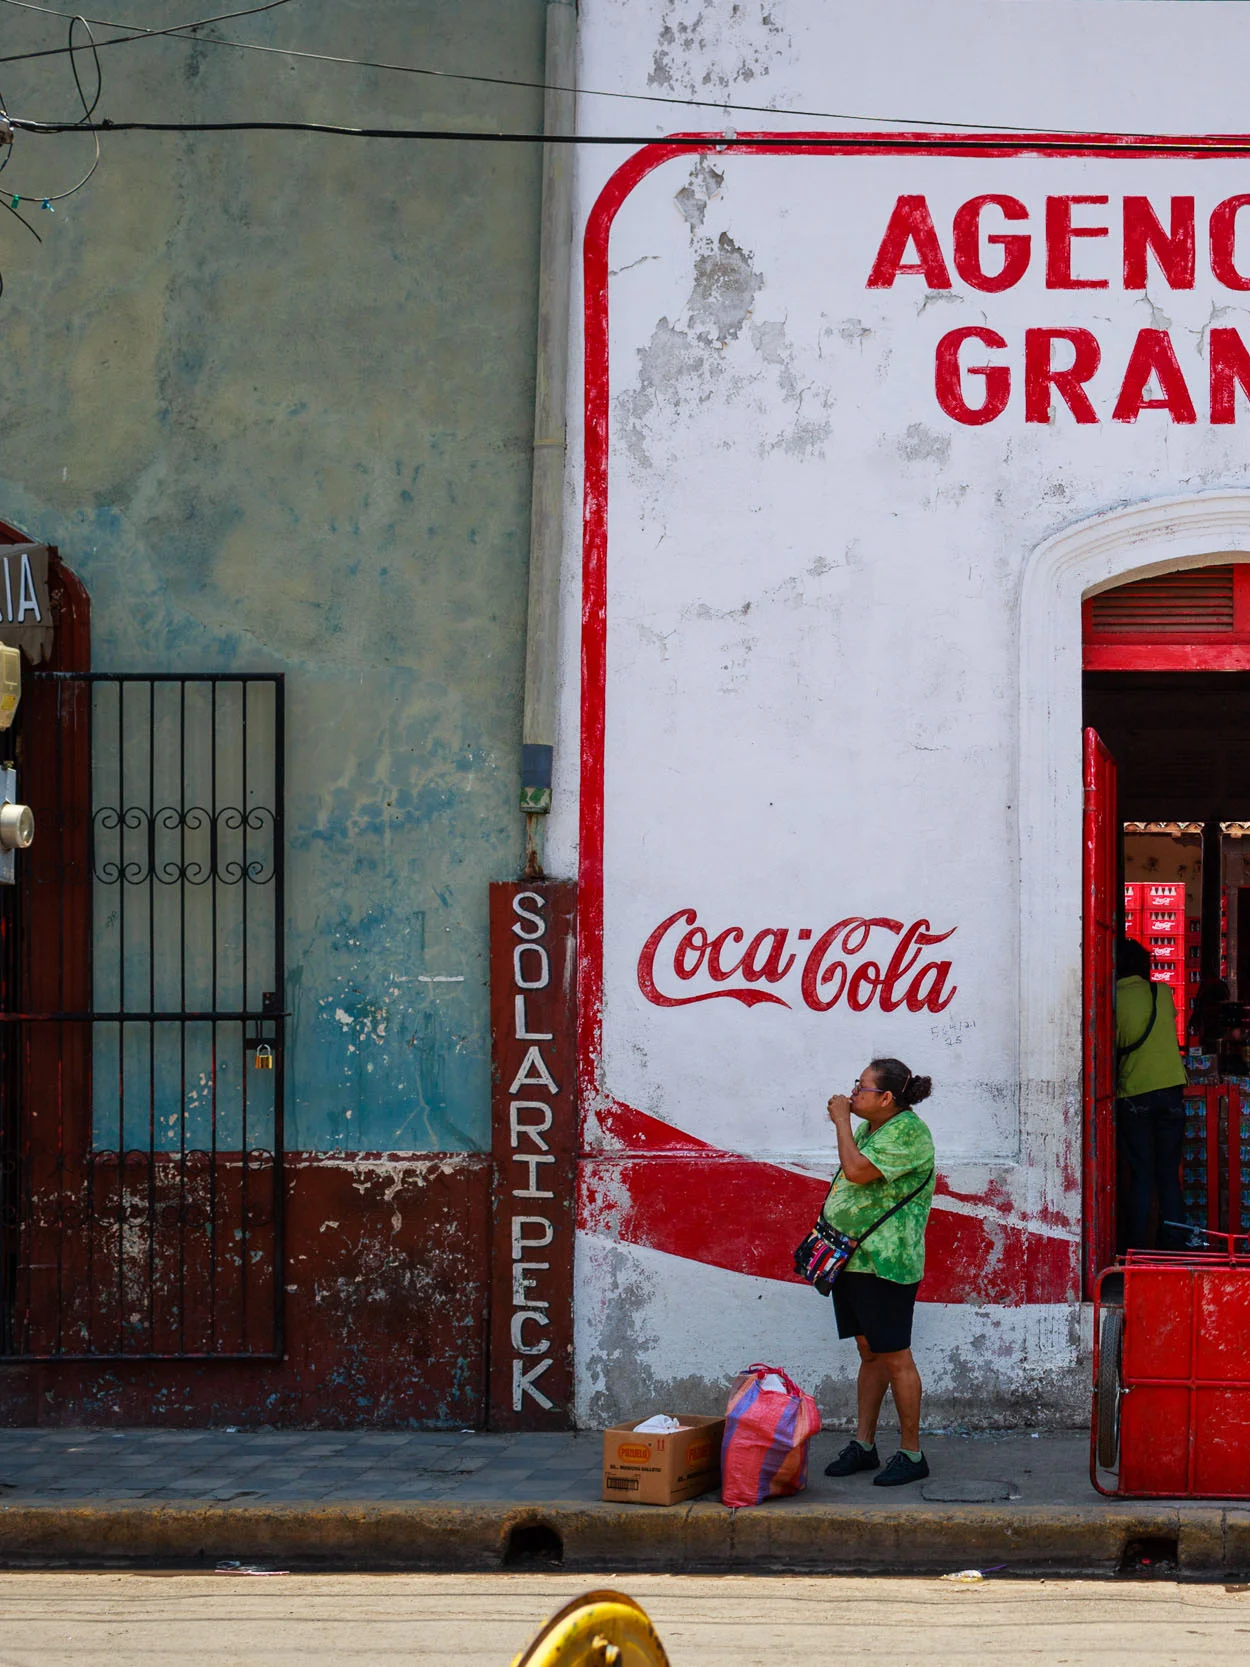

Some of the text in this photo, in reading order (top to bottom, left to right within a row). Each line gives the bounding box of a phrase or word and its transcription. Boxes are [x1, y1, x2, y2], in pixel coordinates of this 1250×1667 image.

[0, 553, 41, 622] IA
[637, 908, 958, 1014] Coca-Cola
[509, 891, 559, 1412] SOLARI PECK
